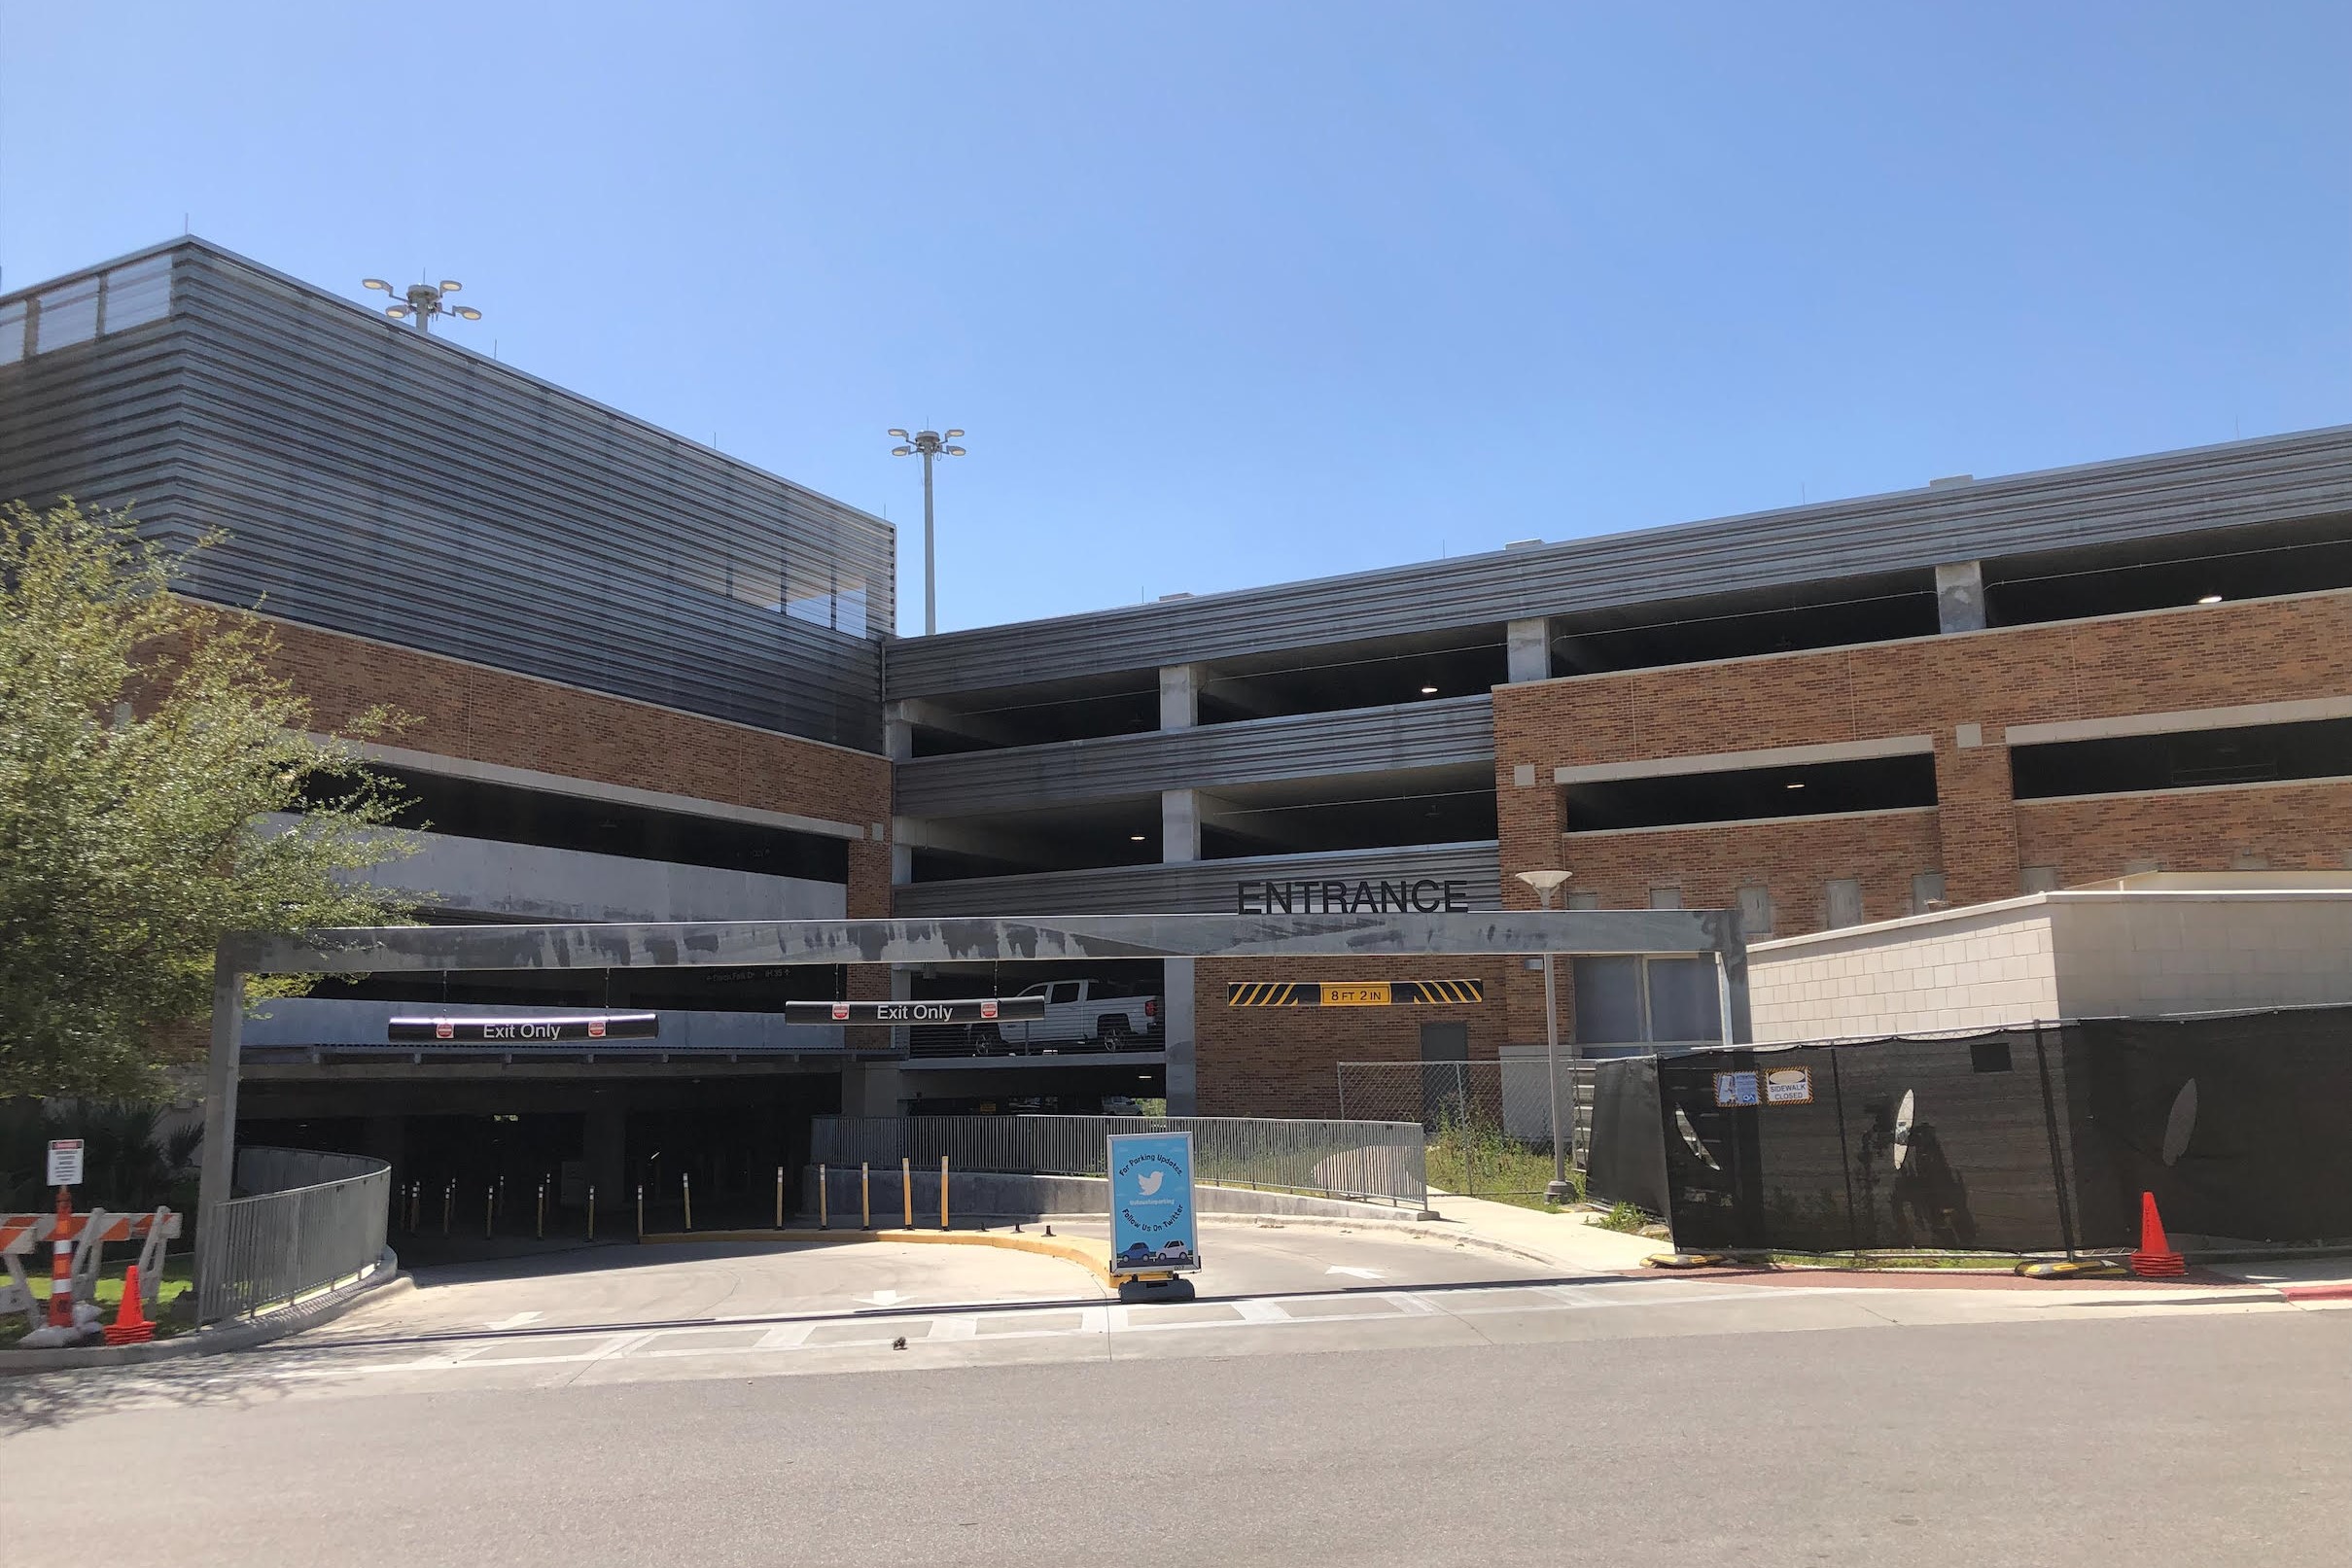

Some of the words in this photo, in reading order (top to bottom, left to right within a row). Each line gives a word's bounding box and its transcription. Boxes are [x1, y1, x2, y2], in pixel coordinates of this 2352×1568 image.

[1238, 879, 1469, 915] ENTRANCE
[1330, 990, 1339, 1001] 8
[1342, 991, 1354, 1001] FT
[1359, 990, 1369, 1001] 2
[1370, 990, 1382, 1001] IN
[877, 1004, 908, 1021] Exit
[913, 1003, 953, 1023] Only
[483, 1024, 515, 1039] Exit
[520, 1023, 561, 1041] Only
[1771, 1084, 1806, 1093] SIDEWALK
[1119, 1165, 1129, 1176] For
[1129, 1154, 1156, 1167] Parking
[1122, 1208, 1141, 1229] Follow
[1141, 1223, 1152, 1233] Us
[1162, 1203, 1183, 1228] Twitter
